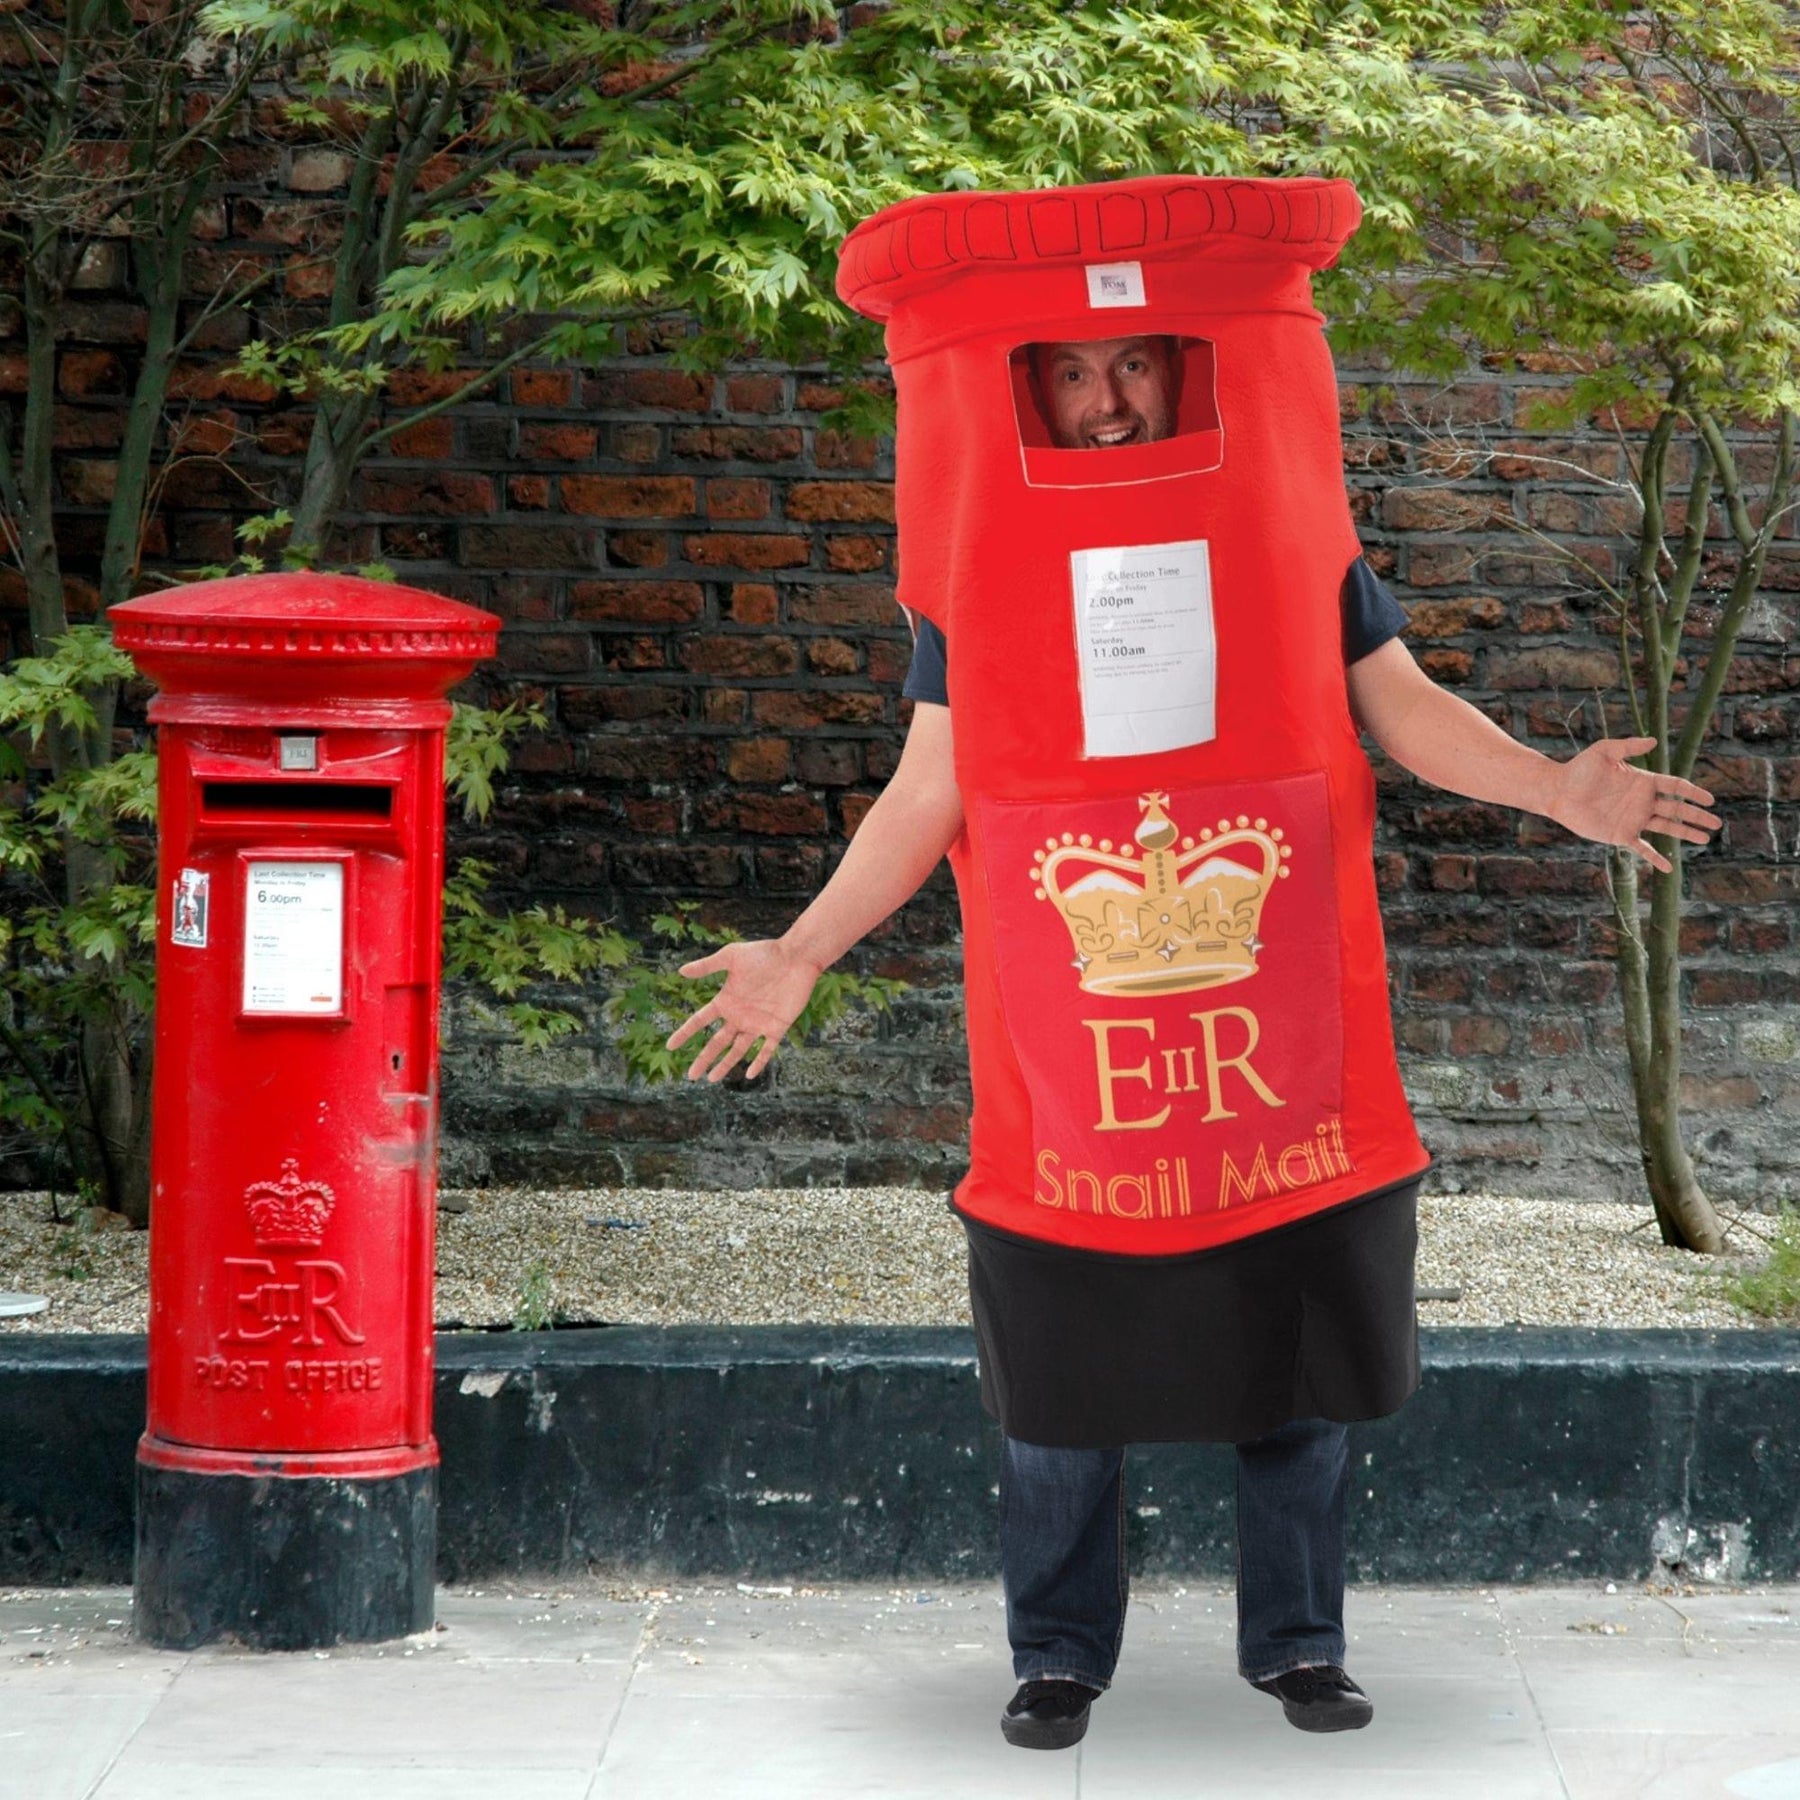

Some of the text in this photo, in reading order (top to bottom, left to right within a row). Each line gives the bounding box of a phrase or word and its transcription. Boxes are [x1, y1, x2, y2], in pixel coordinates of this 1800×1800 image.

[1157, 567, 1180, 577] Time
[1089, 596, 1134, 609] 2.00pm
[1091, 637, 1123, 645] Saturday
[1093, 646, 1146, 658] 11.00am
[1034, 1119, 1351, 1219] Snail Mail
[195, 1356, 382, 1390] POST OFFICE
